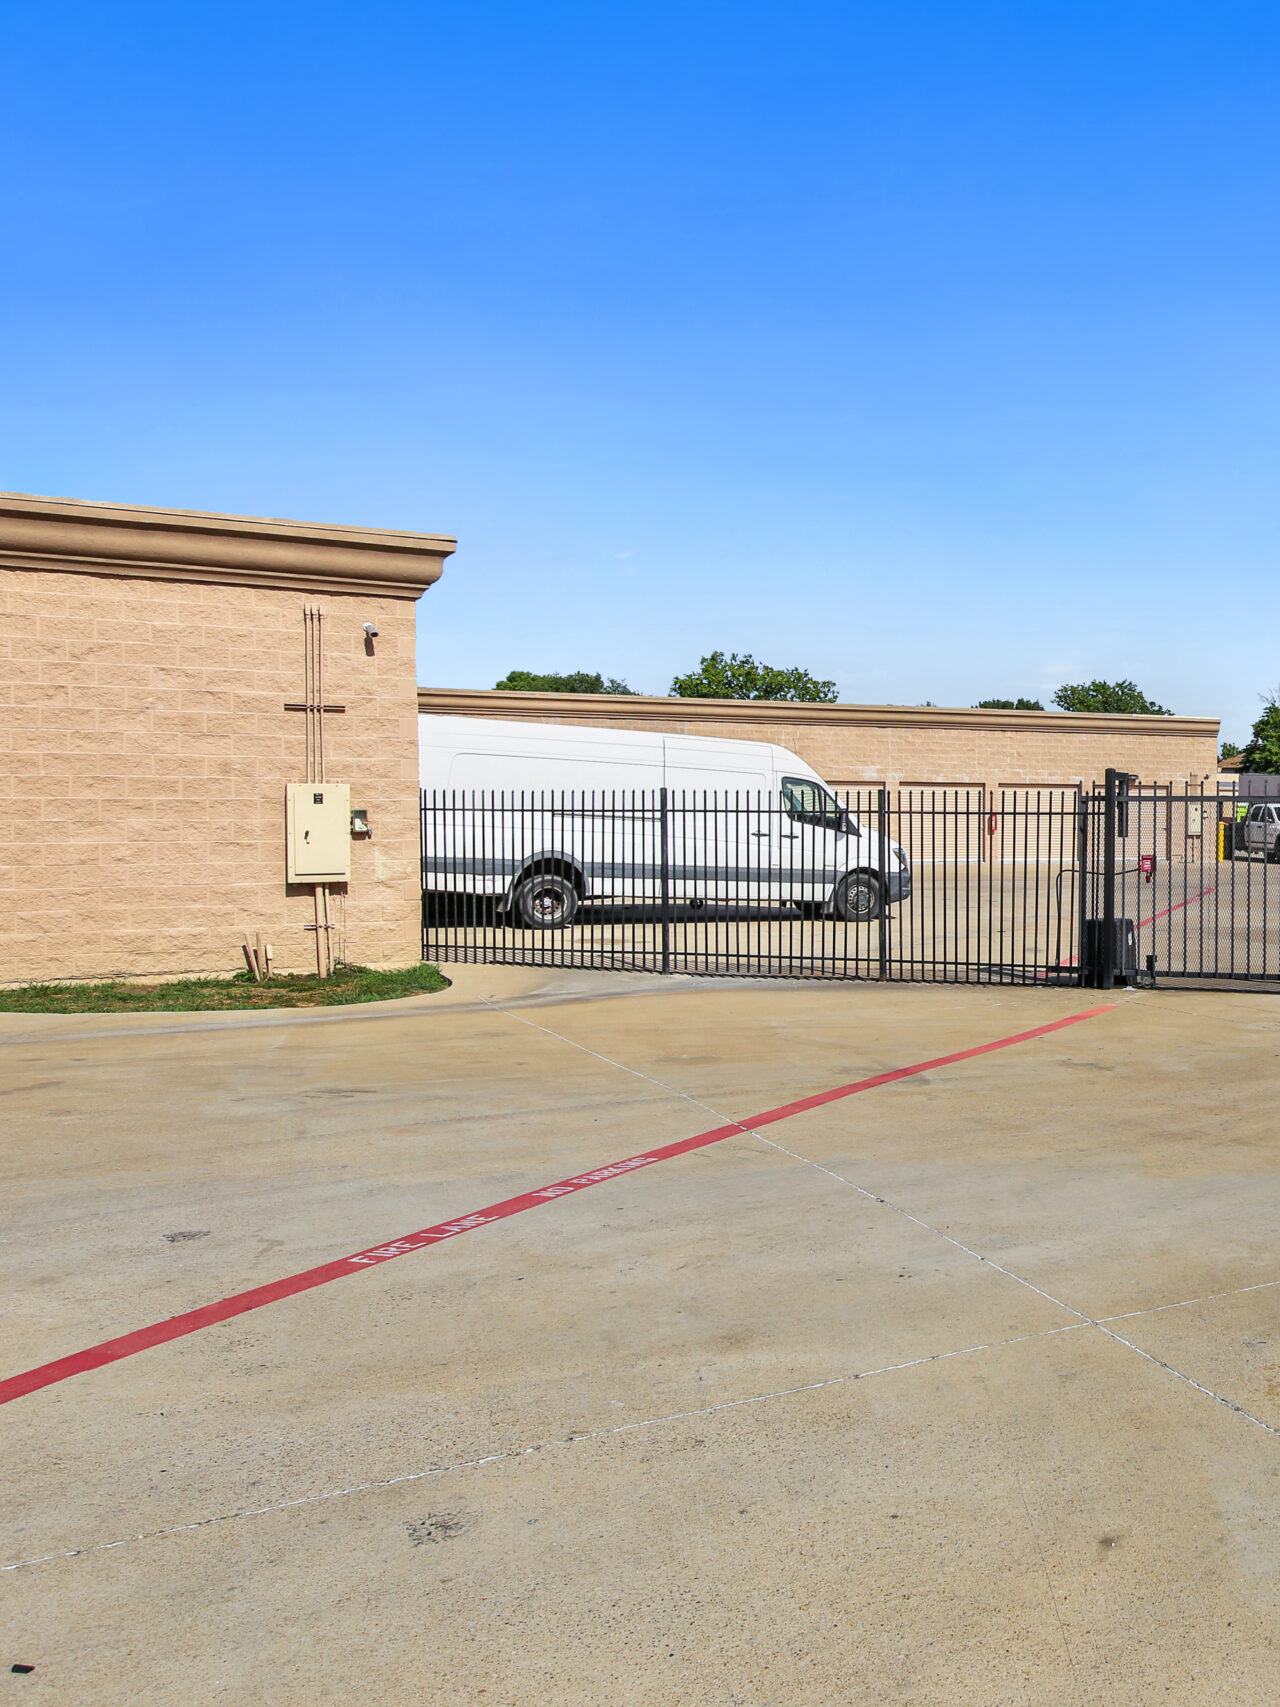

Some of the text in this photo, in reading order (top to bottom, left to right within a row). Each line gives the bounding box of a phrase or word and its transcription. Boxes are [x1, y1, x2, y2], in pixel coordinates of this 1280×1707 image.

[347, 1156, 659, 1264] FIRE LANE NO PARKING
